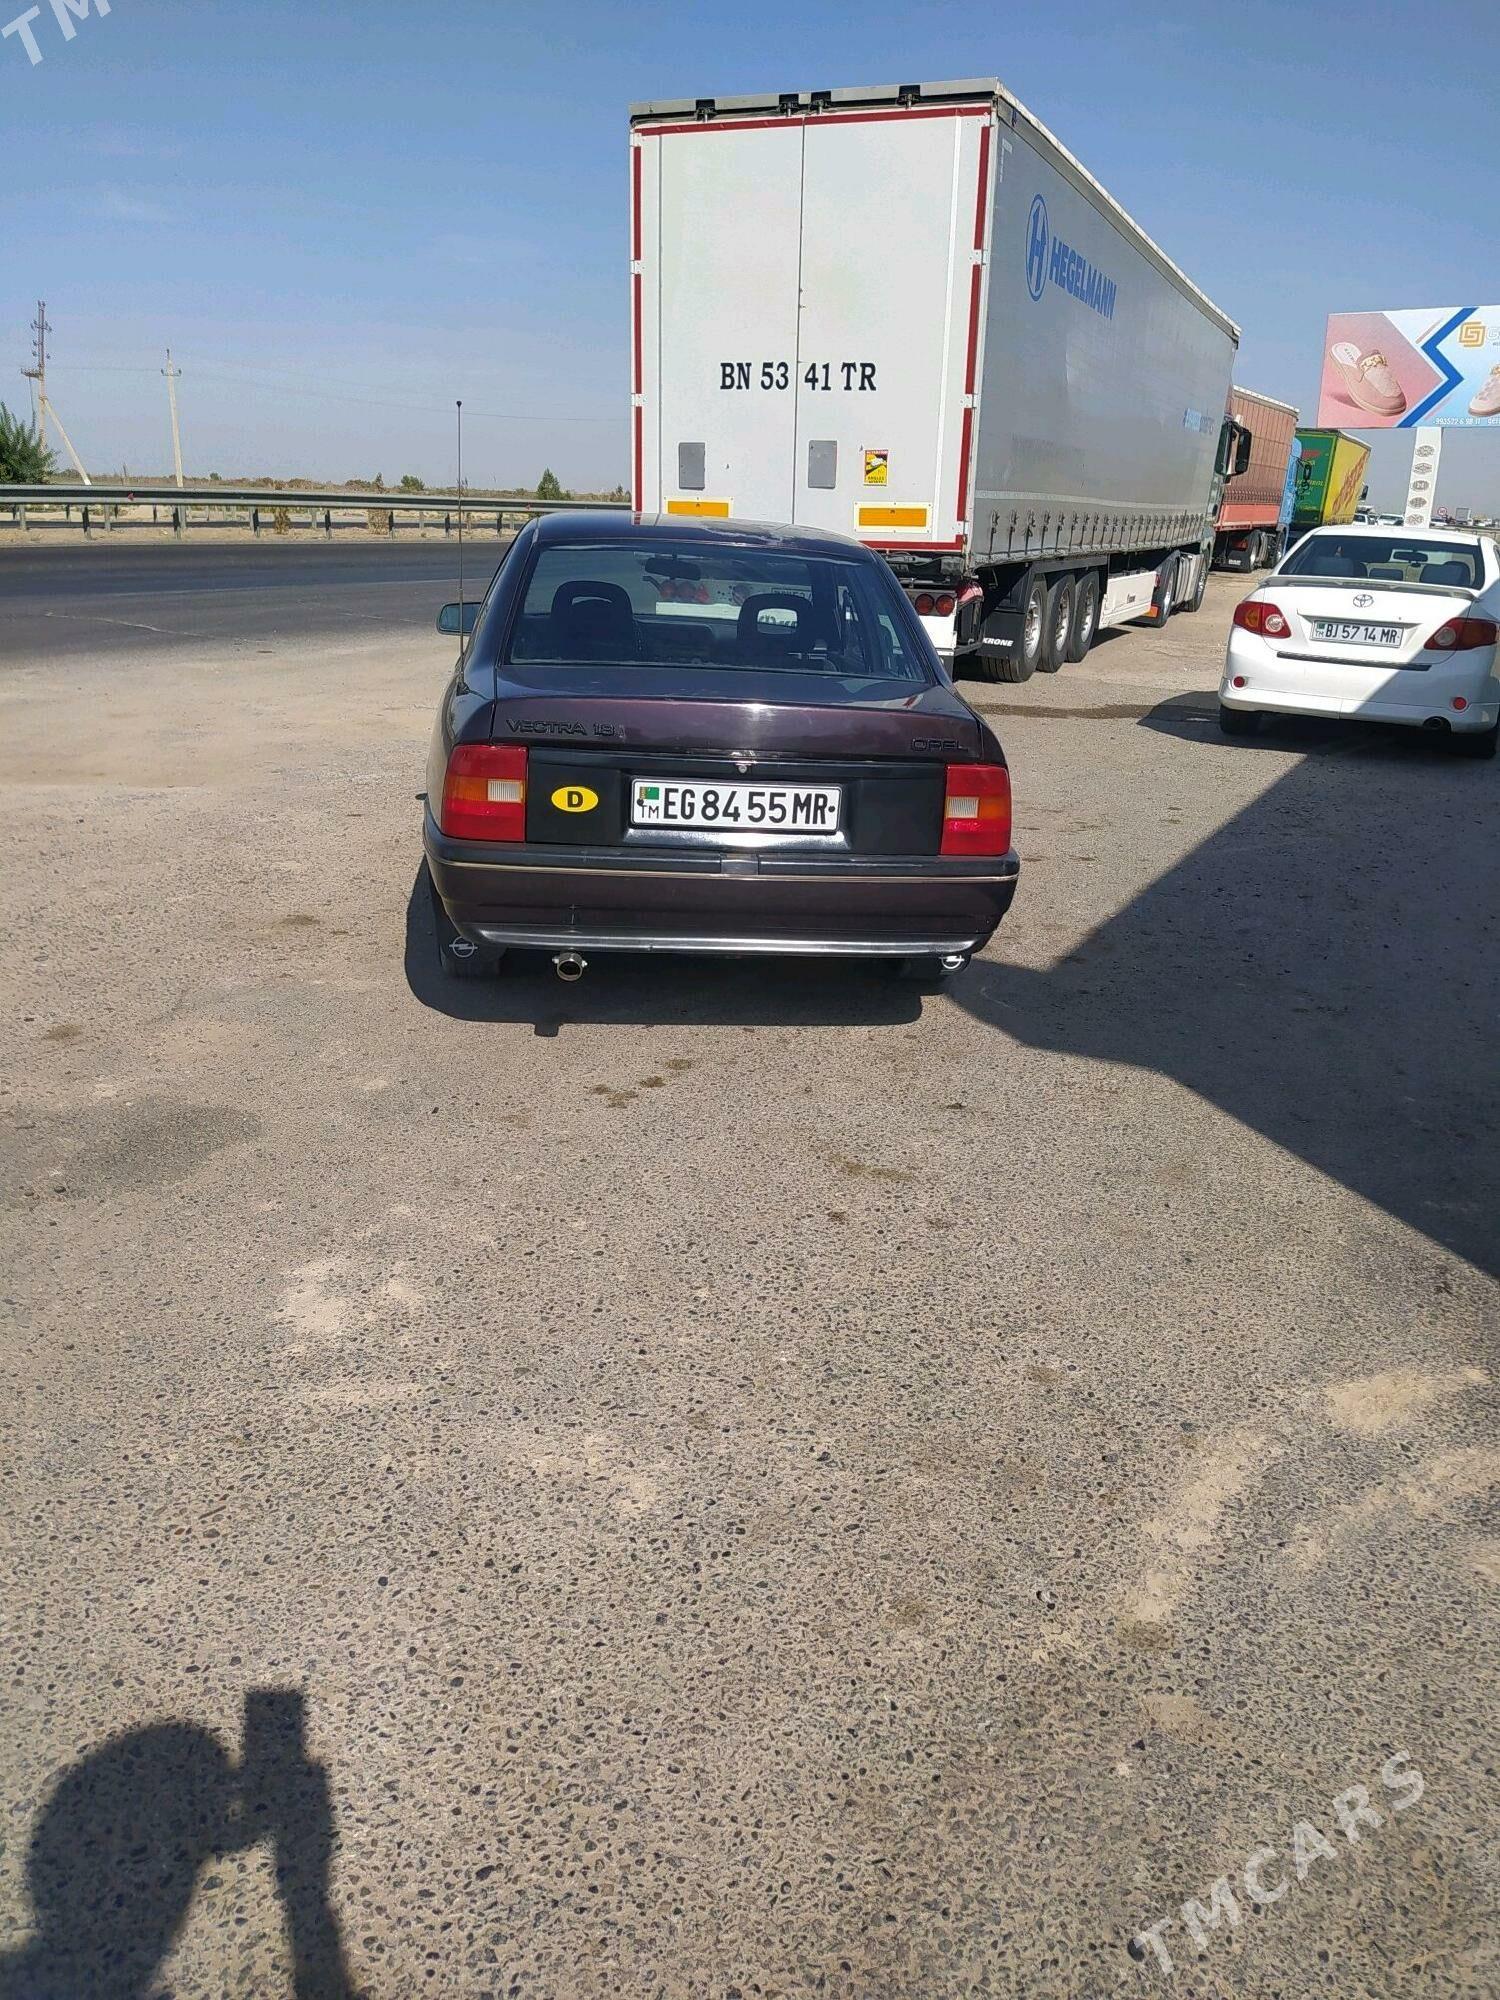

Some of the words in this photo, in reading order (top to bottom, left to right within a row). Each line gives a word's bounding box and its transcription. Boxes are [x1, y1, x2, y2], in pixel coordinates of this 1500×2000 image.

[1049, 236, 1117, 320] HEGELMANN
[720, 362, 752, 390] BN
[760, 361, 789, 391] 53
[804, 362, 831, 391] 41
[841, 362, 877, 391] TR
[982, 637, 1014, 647] KRONE
[1325, 624, 1339, 638] BJ
[1342, 624, 1360, 640] 57
[1363, 627, 1377, 642] 14
[1380, 628, 1398, 644] MR
[506, 718, 587, 736] VECTRA
[911, 737, 969, 752] OPEL
[567, 790, 584, 808] D
